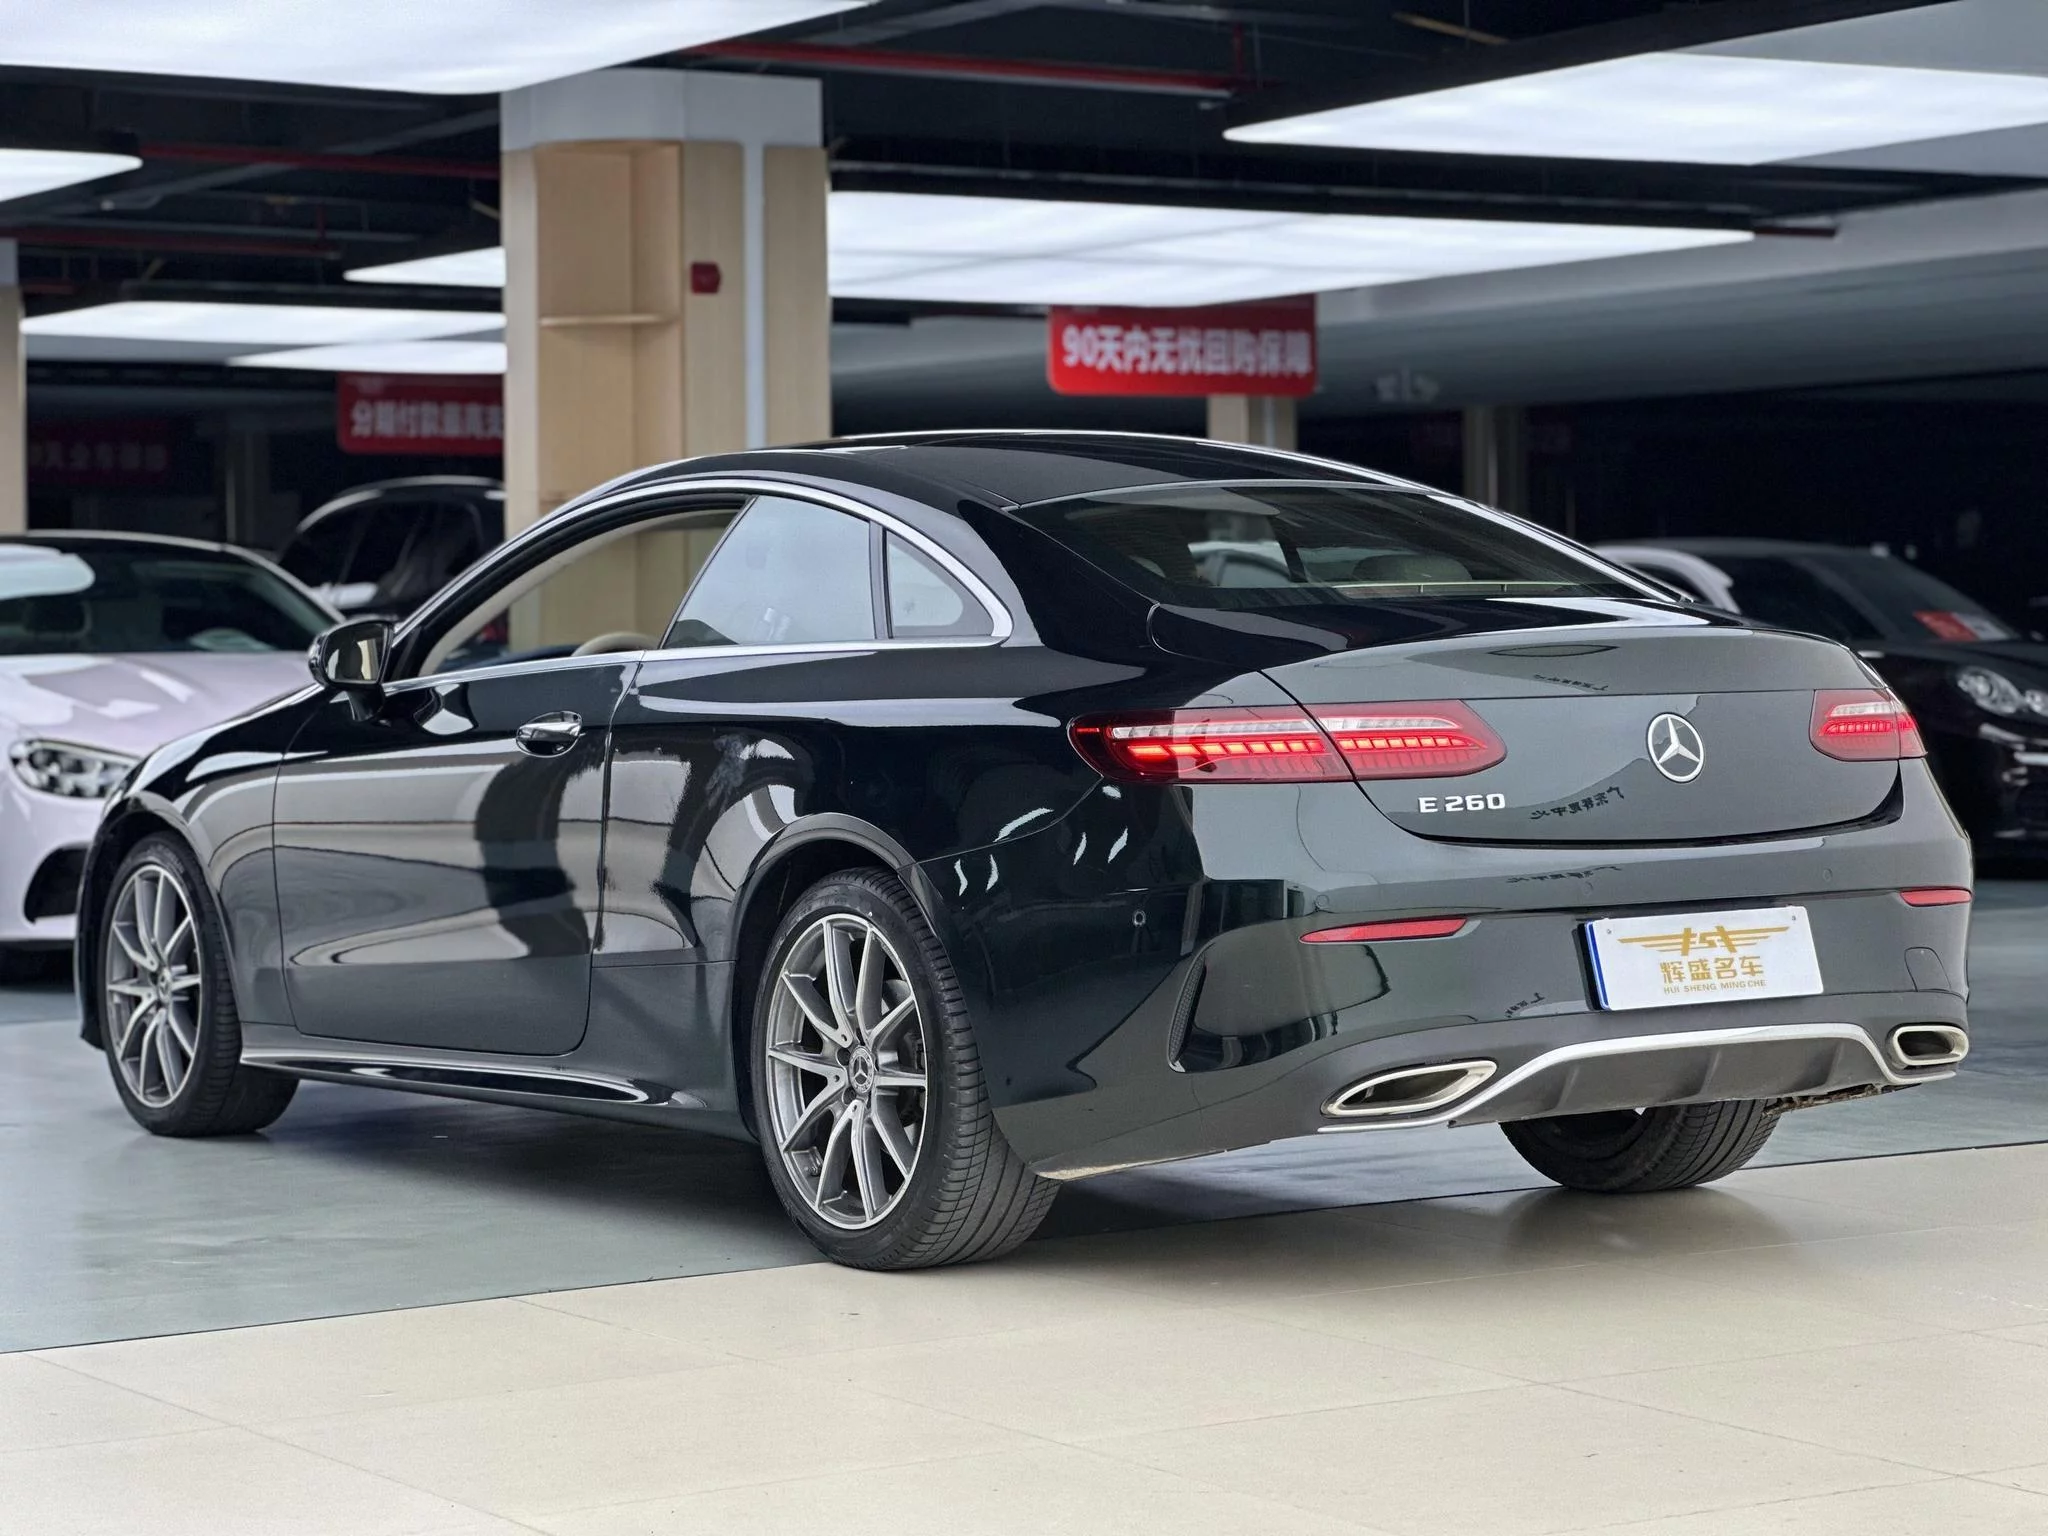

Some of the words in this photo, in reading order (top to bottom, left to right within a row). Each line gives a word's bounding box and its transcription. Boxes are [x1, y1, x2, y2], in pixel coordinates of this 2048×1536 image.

[1418, 797, 1438, 813] E
[1444, 793, 1506, 812] 260
[1660, 956, 1764, 984] 辉盛名车
[1664, 985, 1680, 995] HUI
[1684, 983, 1717, 993] SHENG
[1720, 980, 1746, 989] MING
[1747, 979, 1766, 987] CHE
